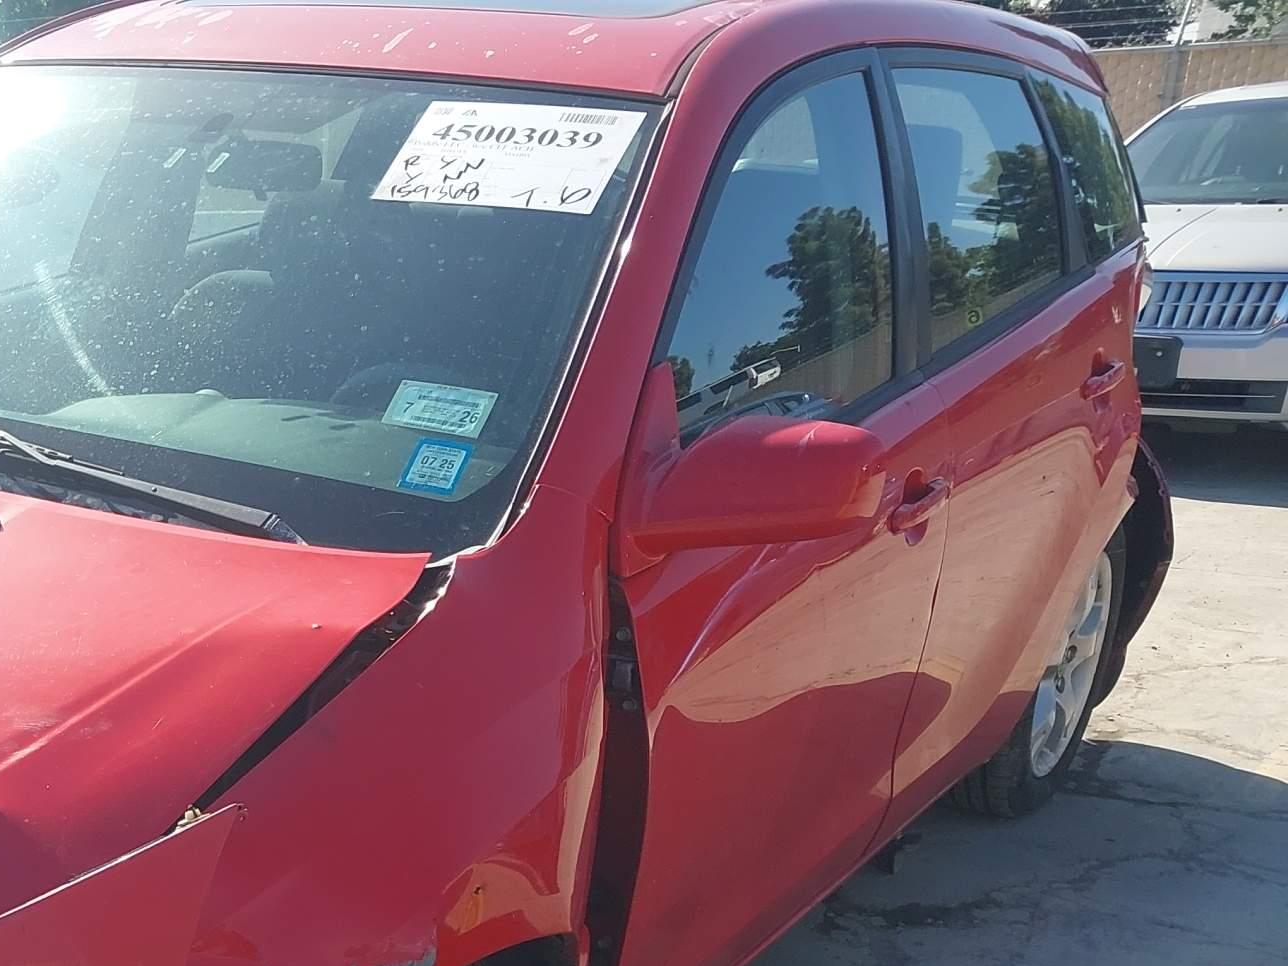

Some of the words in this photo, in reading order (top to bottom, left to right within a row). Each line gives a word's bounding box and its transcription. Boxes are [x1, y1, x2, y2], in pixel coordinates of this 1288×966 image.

[432, 122, 603, 149] 45003039
[402, 402, 413, 413] 7
[459, 411, 480, 424] 26
[421, 455, 438, 466] 07
[439, 458, 456, 470] 25
